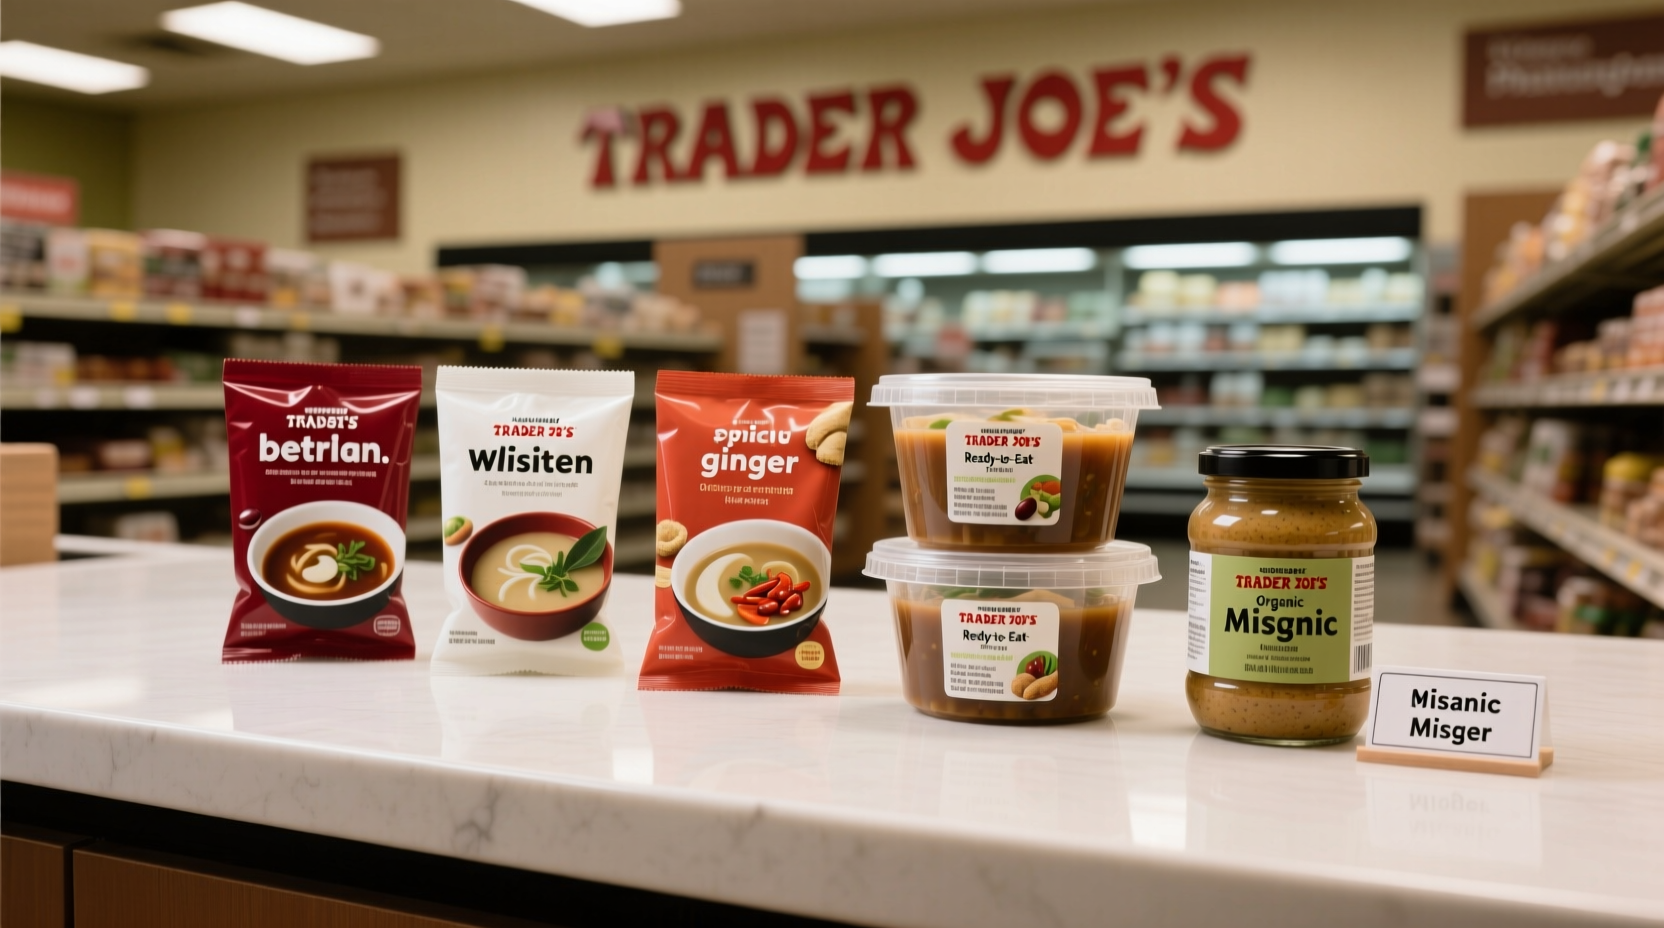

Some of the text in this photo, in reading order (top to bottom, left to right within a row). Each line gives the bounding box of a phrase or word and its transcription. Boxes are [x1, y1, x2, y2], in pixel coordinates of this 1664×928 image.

[582, 53, 1251, 189] TRADER JOE'S
[701, 446, 799, 480] ginger
[1235, 574, 1291, 590] TRADER
[1256, 595, 1305, 612] Organic
[1224, 607, 1338, 643] Misgnic
[1411, 688, 1501, 714] Misanic
[1409, 717, 1493, 745] Misger
